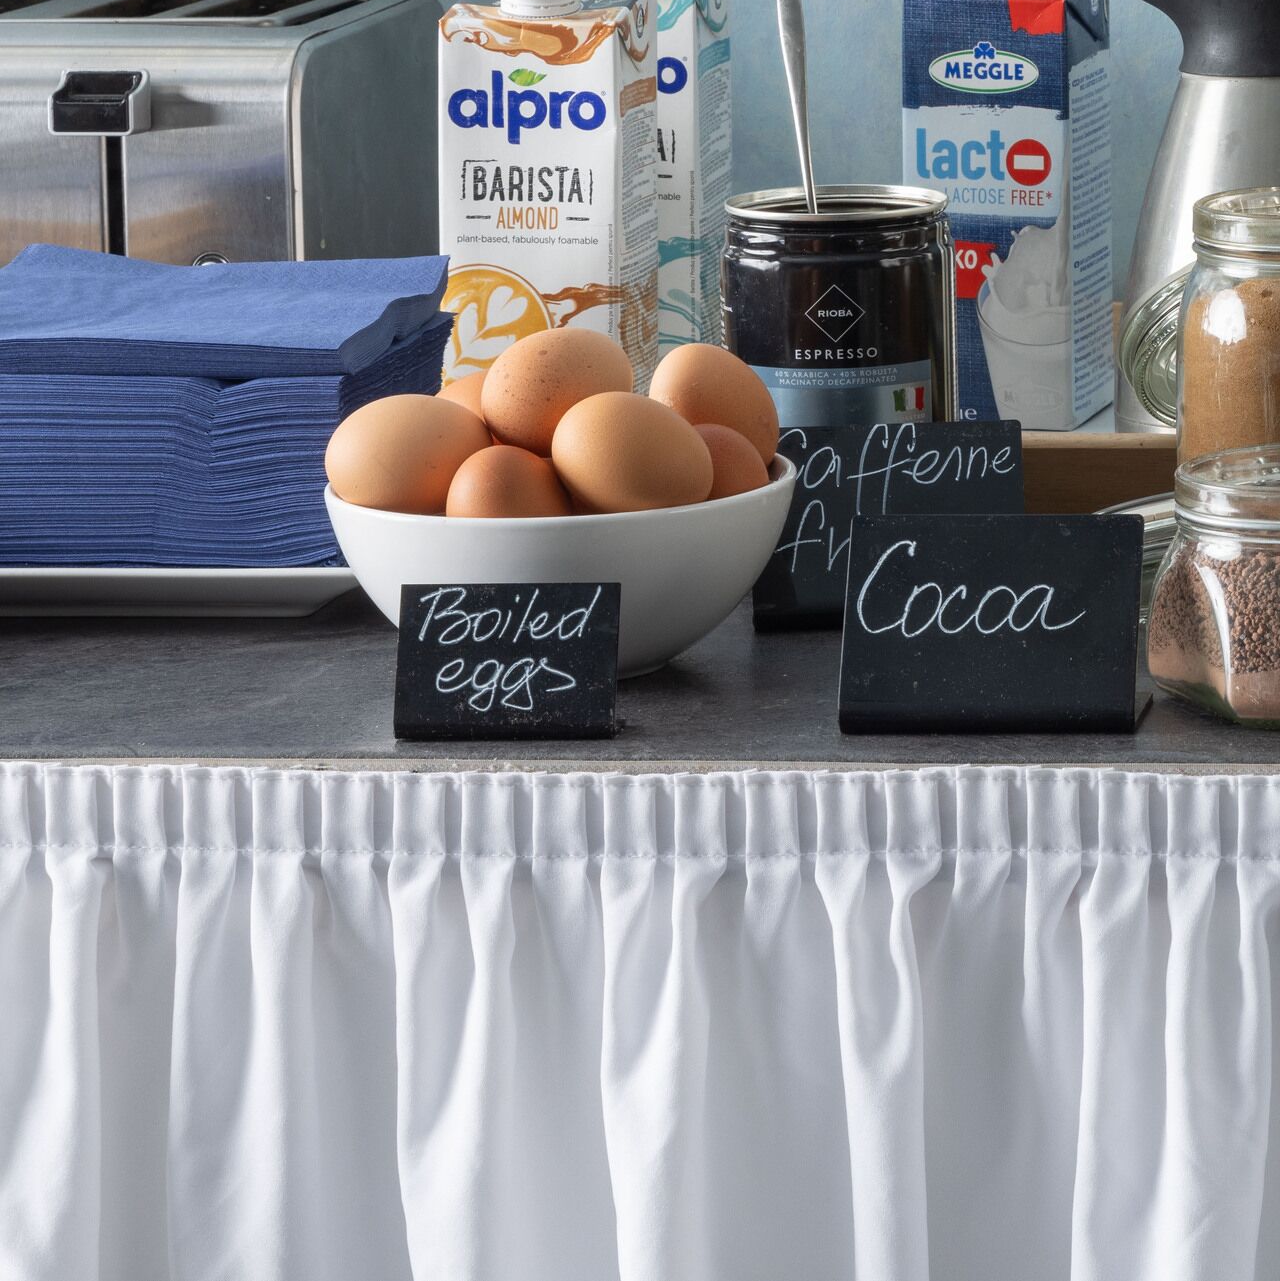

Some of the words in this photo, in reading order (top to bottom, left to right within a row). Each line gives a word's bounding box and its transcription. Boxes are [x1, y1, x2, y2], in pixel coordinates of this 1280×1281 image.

[944, 62, 1024, 81] MEGGLE
[447, 69, 607, 145] alpro
[472, 164, 585, 204] BARISTA
[495, 206, 559, 231] ALMOND
[456, 234, 511, 245] plant-based,
[511, 235, 557, 247] fabulously
[557, 236, 600, 246] foamable
[817, 308, 854, 318] RIOBA
[794, 346, 879, 361] ESPRESSO
[779, 378, 825, 386] MACINATO
[791, 370, 830, 379] ARABICA
[840, 370, 857, 378] 40%
[860, 367, 899, 377] ROBUSTA
[856, 539, 1089, 638] Cocoa
[418, 585, 602, 645] Boiled
[436, 657, 577, 712] eggs
